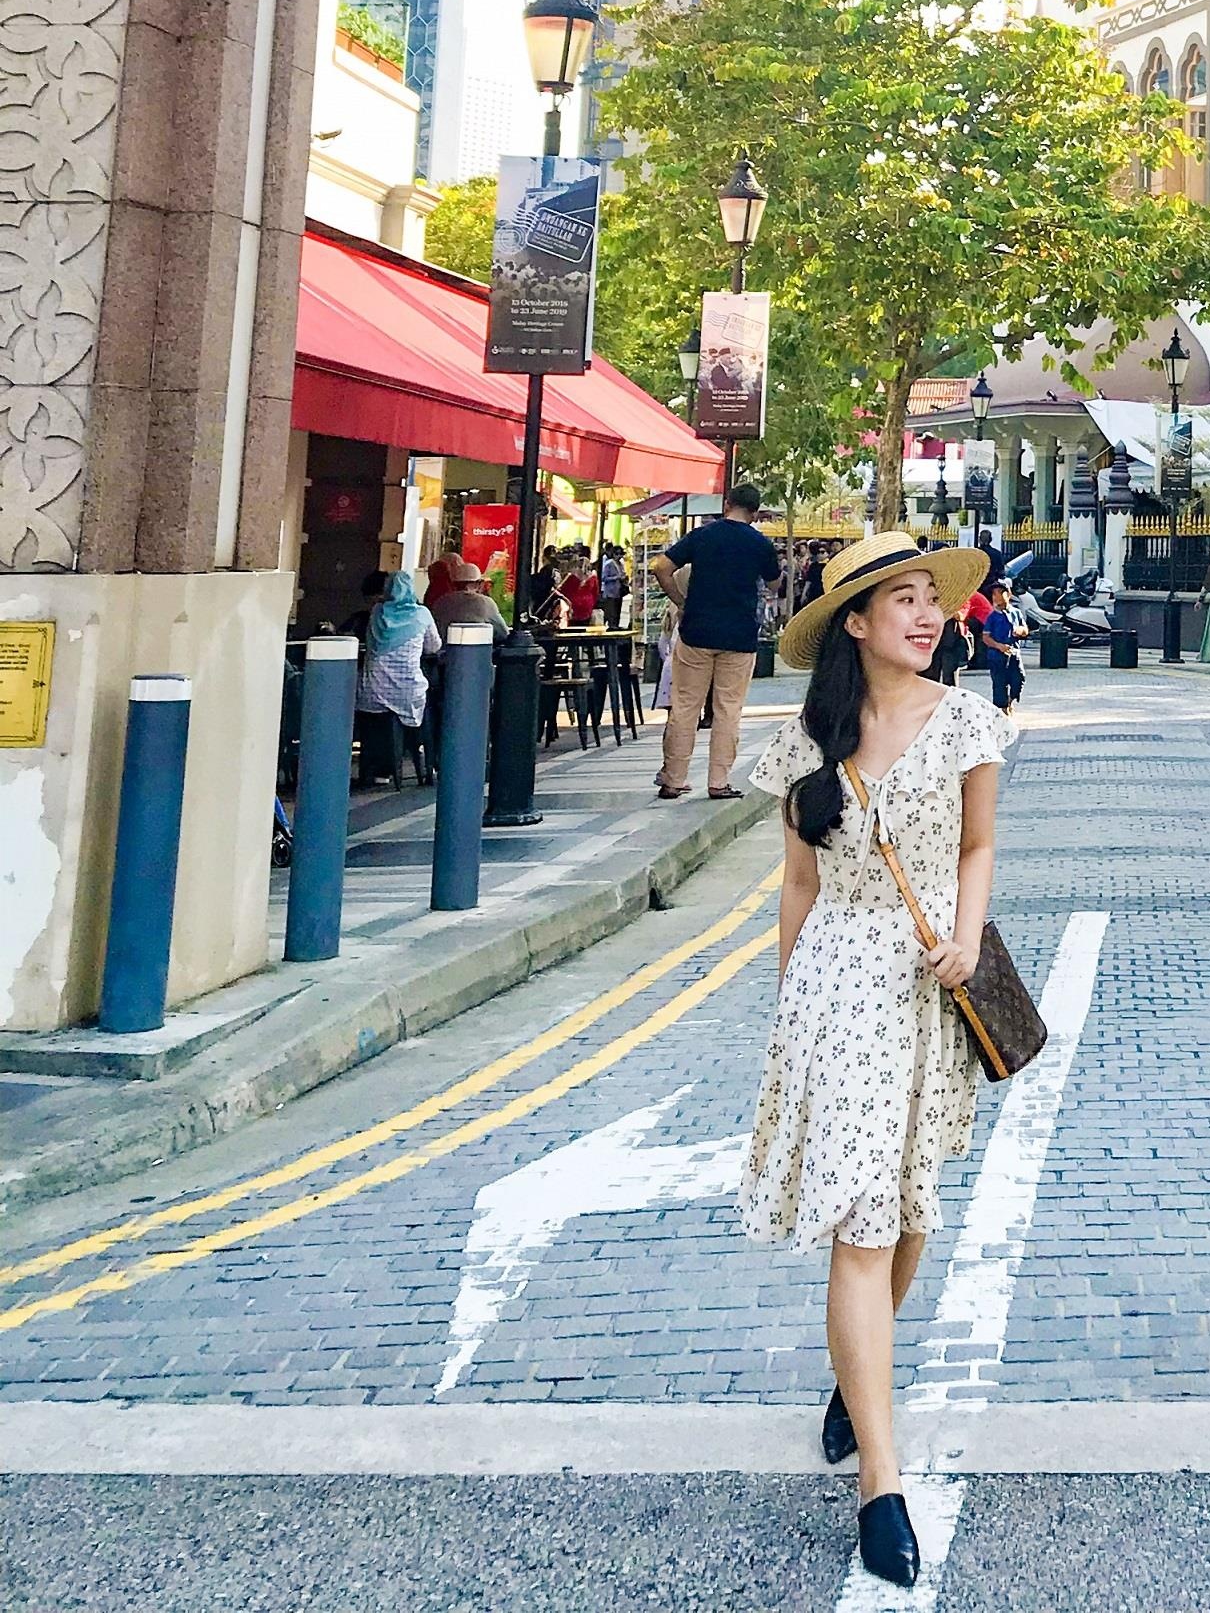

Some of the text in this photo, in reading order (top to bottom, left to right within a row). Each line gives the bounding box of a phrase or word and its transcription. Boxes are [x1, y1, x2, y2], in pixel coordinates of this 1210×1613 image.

[520, 298, 550, 306] October
[530, 307, 548, 315] June
[549, 308, 568, 316] 2019
[473, 527, 506, 537] thirsty?
